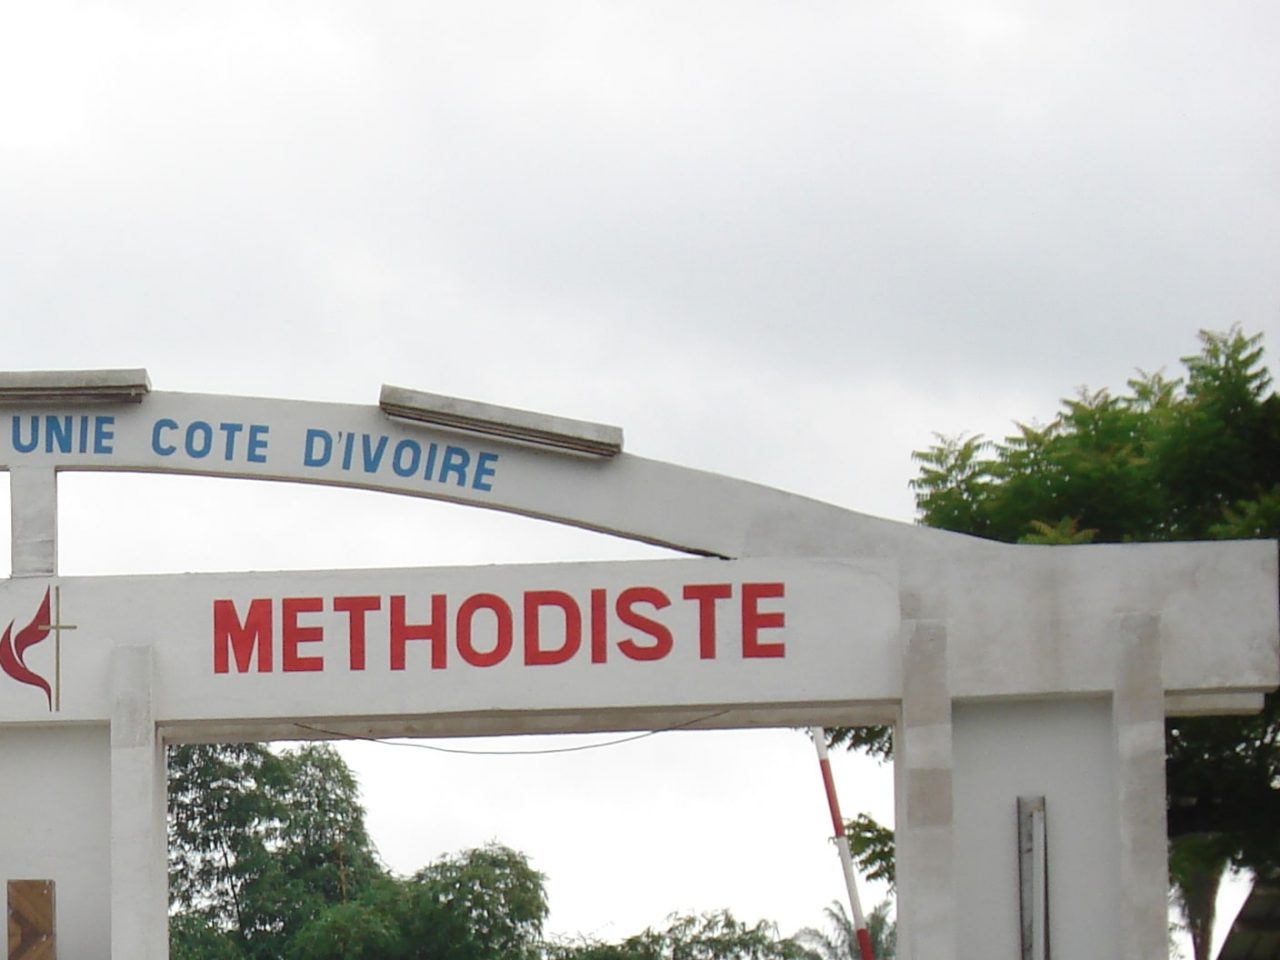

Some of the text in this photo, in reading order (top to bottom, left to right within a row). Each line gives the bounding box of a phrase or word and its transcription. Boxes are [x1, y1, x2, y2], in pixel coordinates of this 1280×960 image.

[11, 414, 115, 455] UNIE
[151, 418, 269, 464] COTE
[303, 427, 498, 492] D'IVOIRE
[212, 582, 786, 675] METHODISTE
